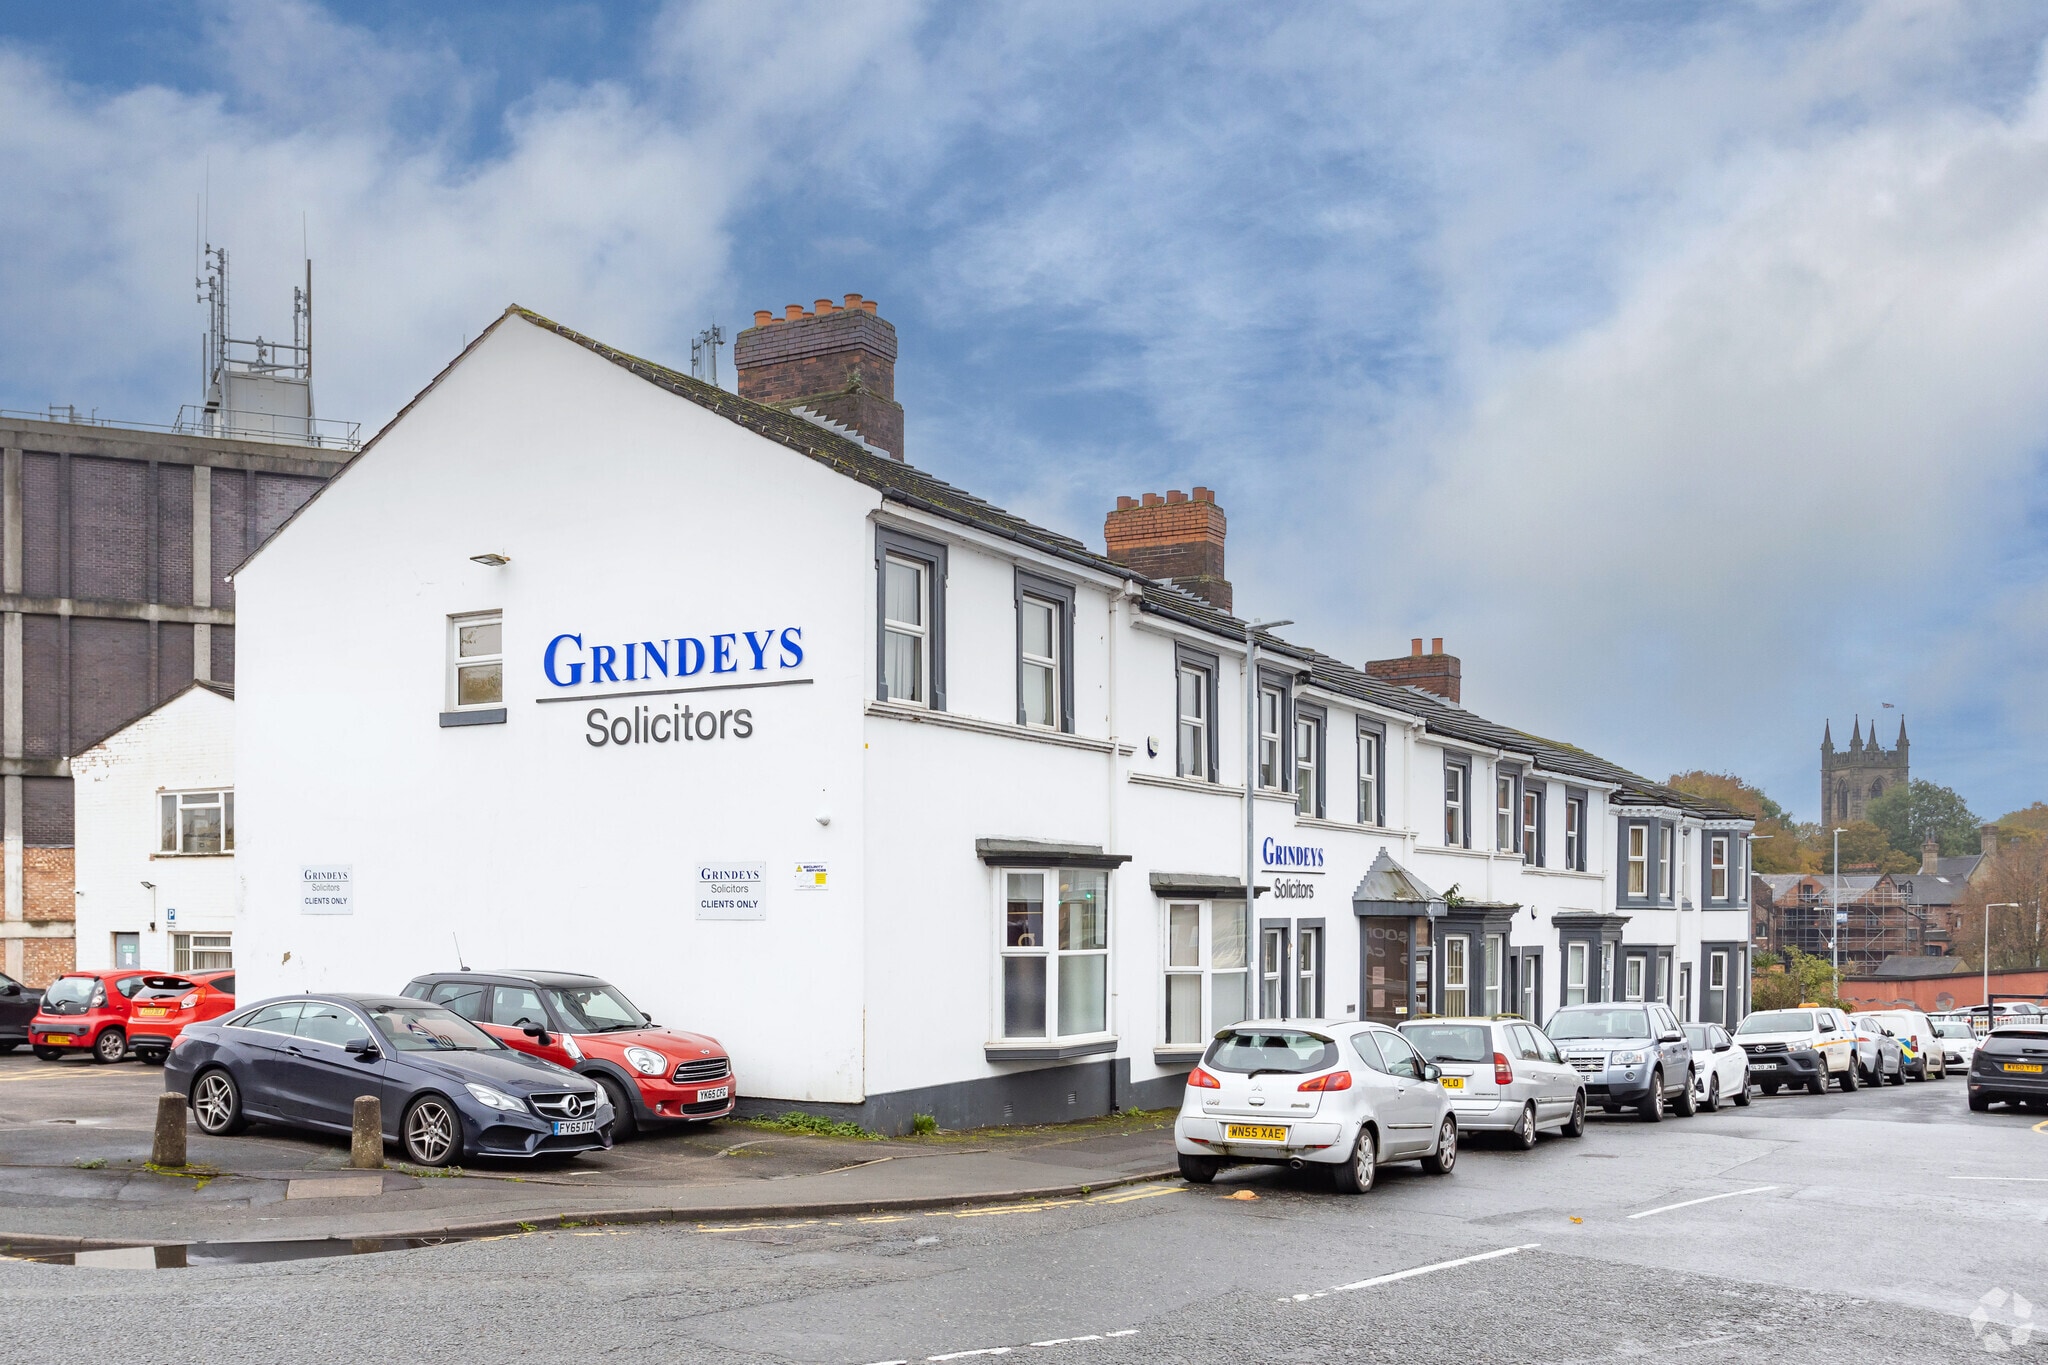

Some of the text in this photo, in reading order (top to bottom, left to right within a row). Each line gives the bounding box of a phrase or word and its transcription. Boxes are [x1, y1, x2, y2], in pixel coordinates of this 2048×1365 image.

[543, 626, 804, 688] GRINDEYS
[585, 703, 754, 747] Solicitors
[1262, 836, 1324, 867] GRINDEYS
[304, 869, 348, 880] GRINDEYS
[701, 867, 760, 880] GRINDEYS
[311, 883, 341, 892] Solicitors
[711, 884, 749, 894] Solicitors
[1274, 877, 1314, 899] Solicitors
[304, 897, 348, 905] CLIENTS ONLY
[701, 900, 759, 909] CLIENTS ONLY
[700, 1089, 716, 1100] YK65
[559, 1120, 594, 1133] FY65 DTZ
[1231, 1125, 1282, 1139] WN55 XAE
